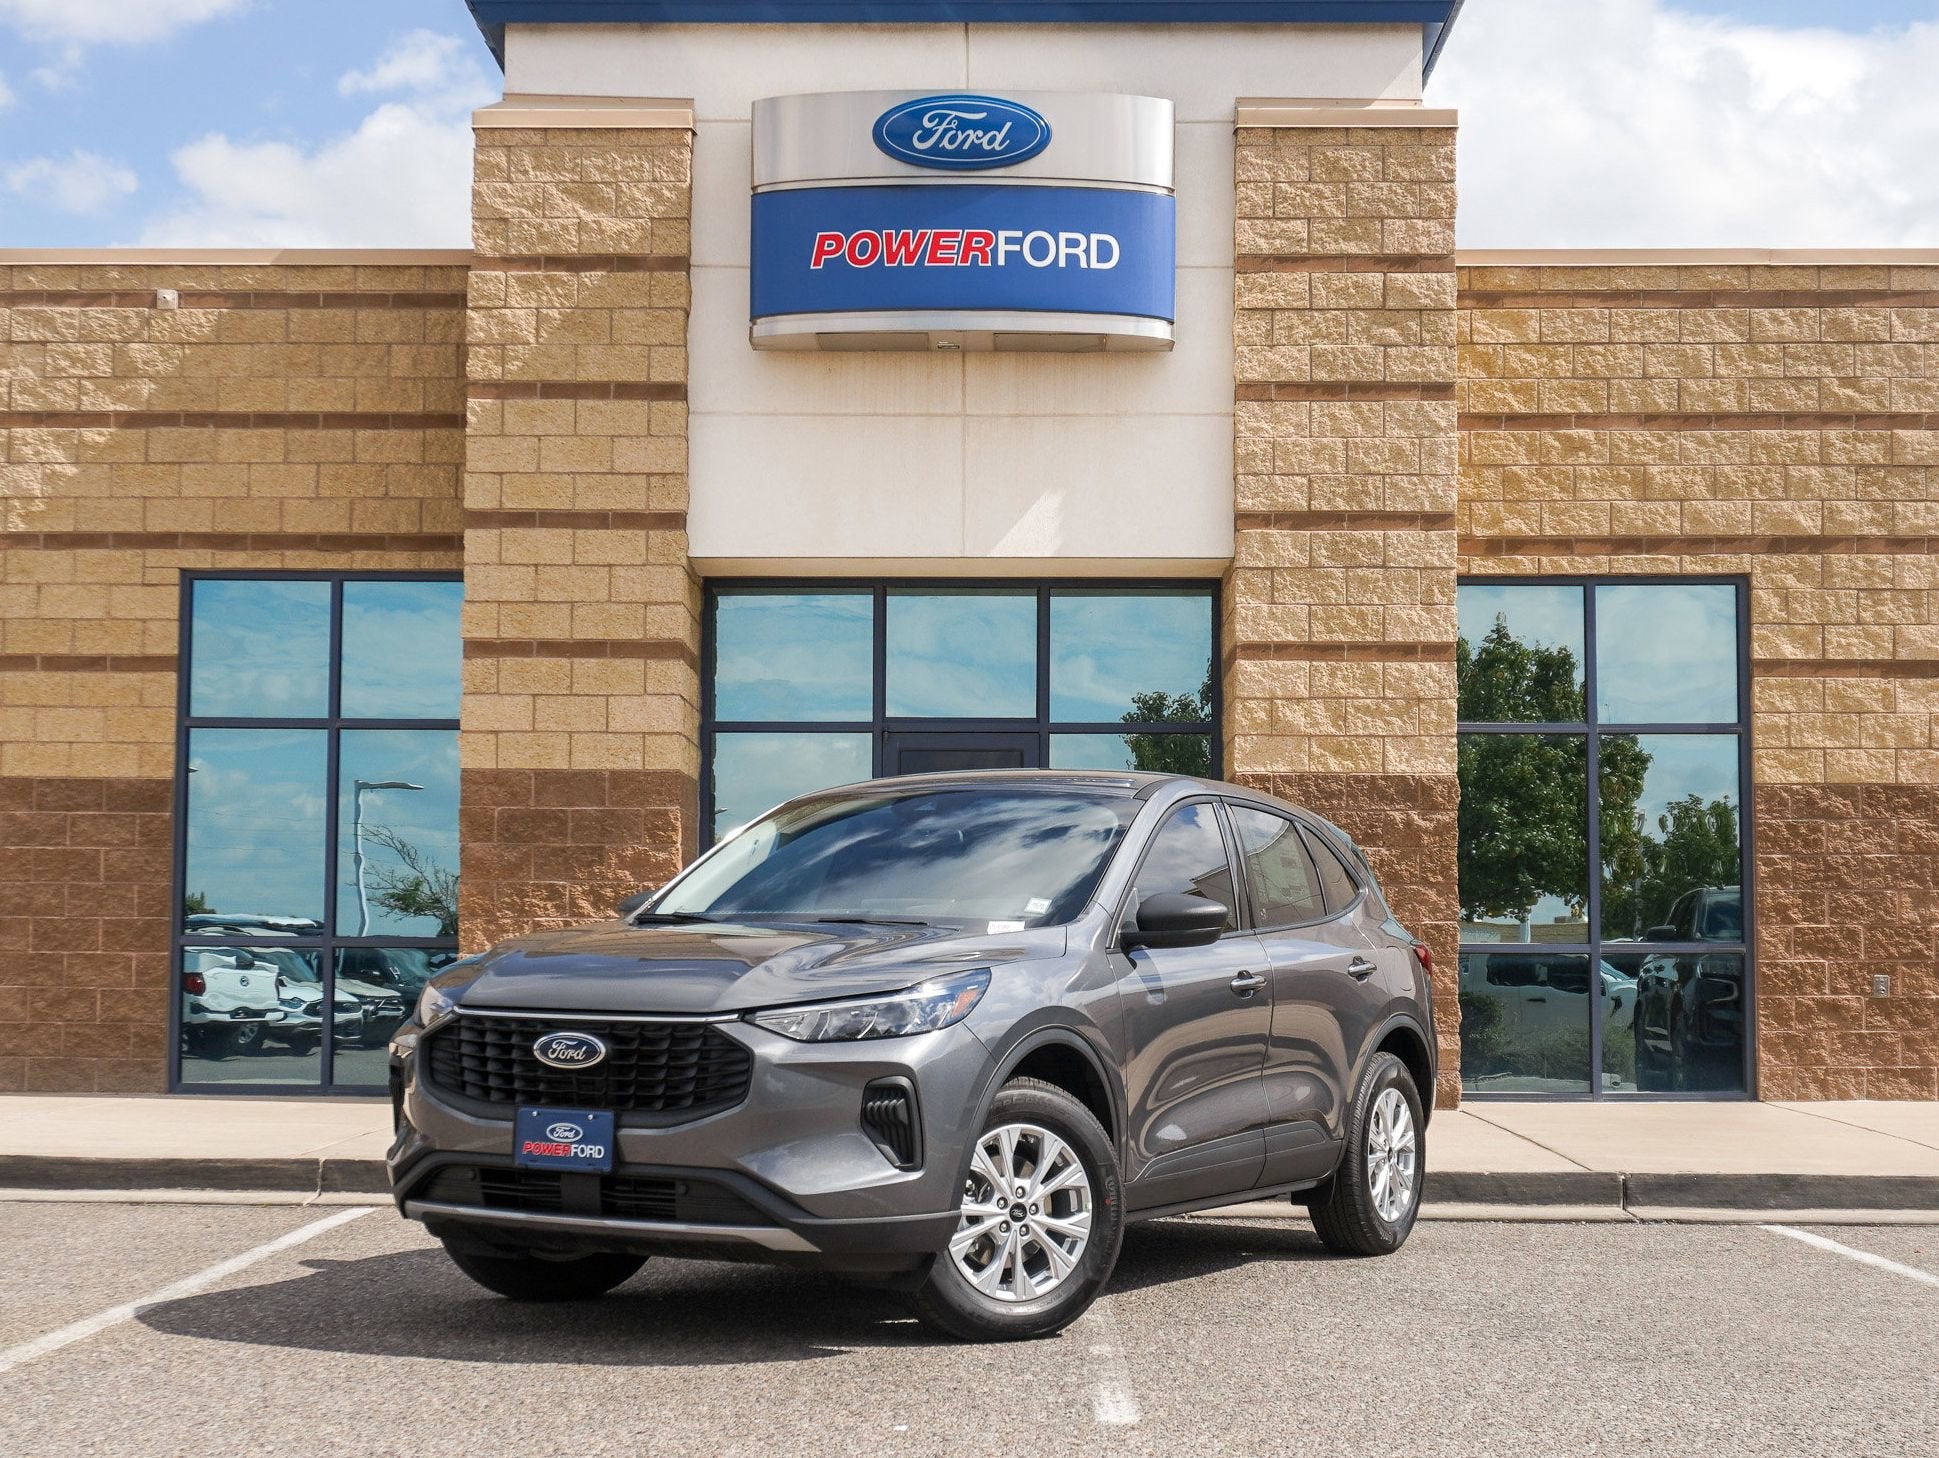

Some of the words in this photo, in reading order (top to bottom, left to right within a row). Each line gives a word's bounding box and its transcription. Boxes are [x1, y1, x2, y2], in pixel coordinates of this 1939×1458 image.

[912, 109, 1010, 151] Ford
[810, 229, 1120, 270] POWERFORD
[548, 1039, 587, 1060] Ford
[553, 1126, 576, 1138] Ford
